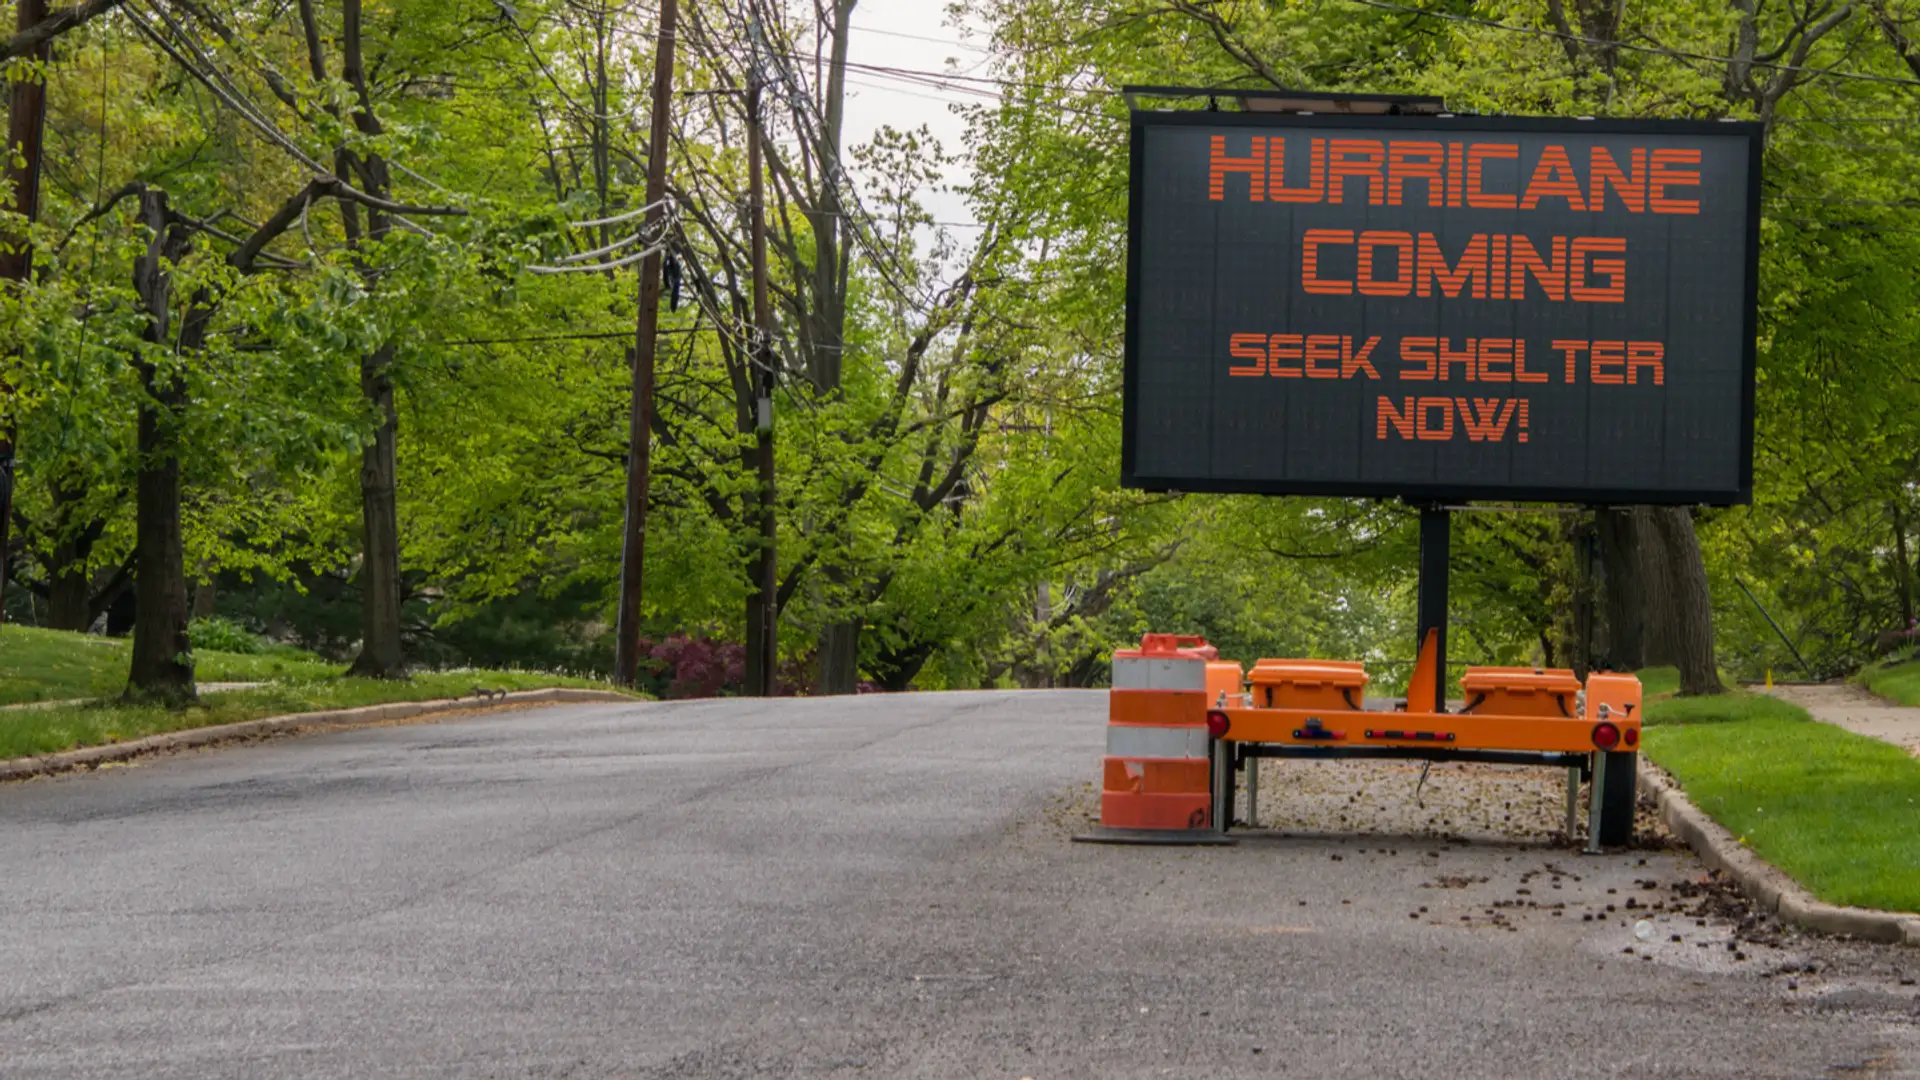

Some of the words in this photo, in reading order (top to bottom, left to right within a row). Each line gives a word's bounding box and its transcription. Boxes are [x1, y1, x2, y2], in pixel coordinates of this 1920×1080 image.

[1208, 135, 1702, 215] HURRICANE
[1302, 229, 1627, 303] COMING
[1229, 333, 1381, 379] SEEK
[1399, 336, 1665, 385] SHELTER
[1376, 395, 1529, 443] NOW!
